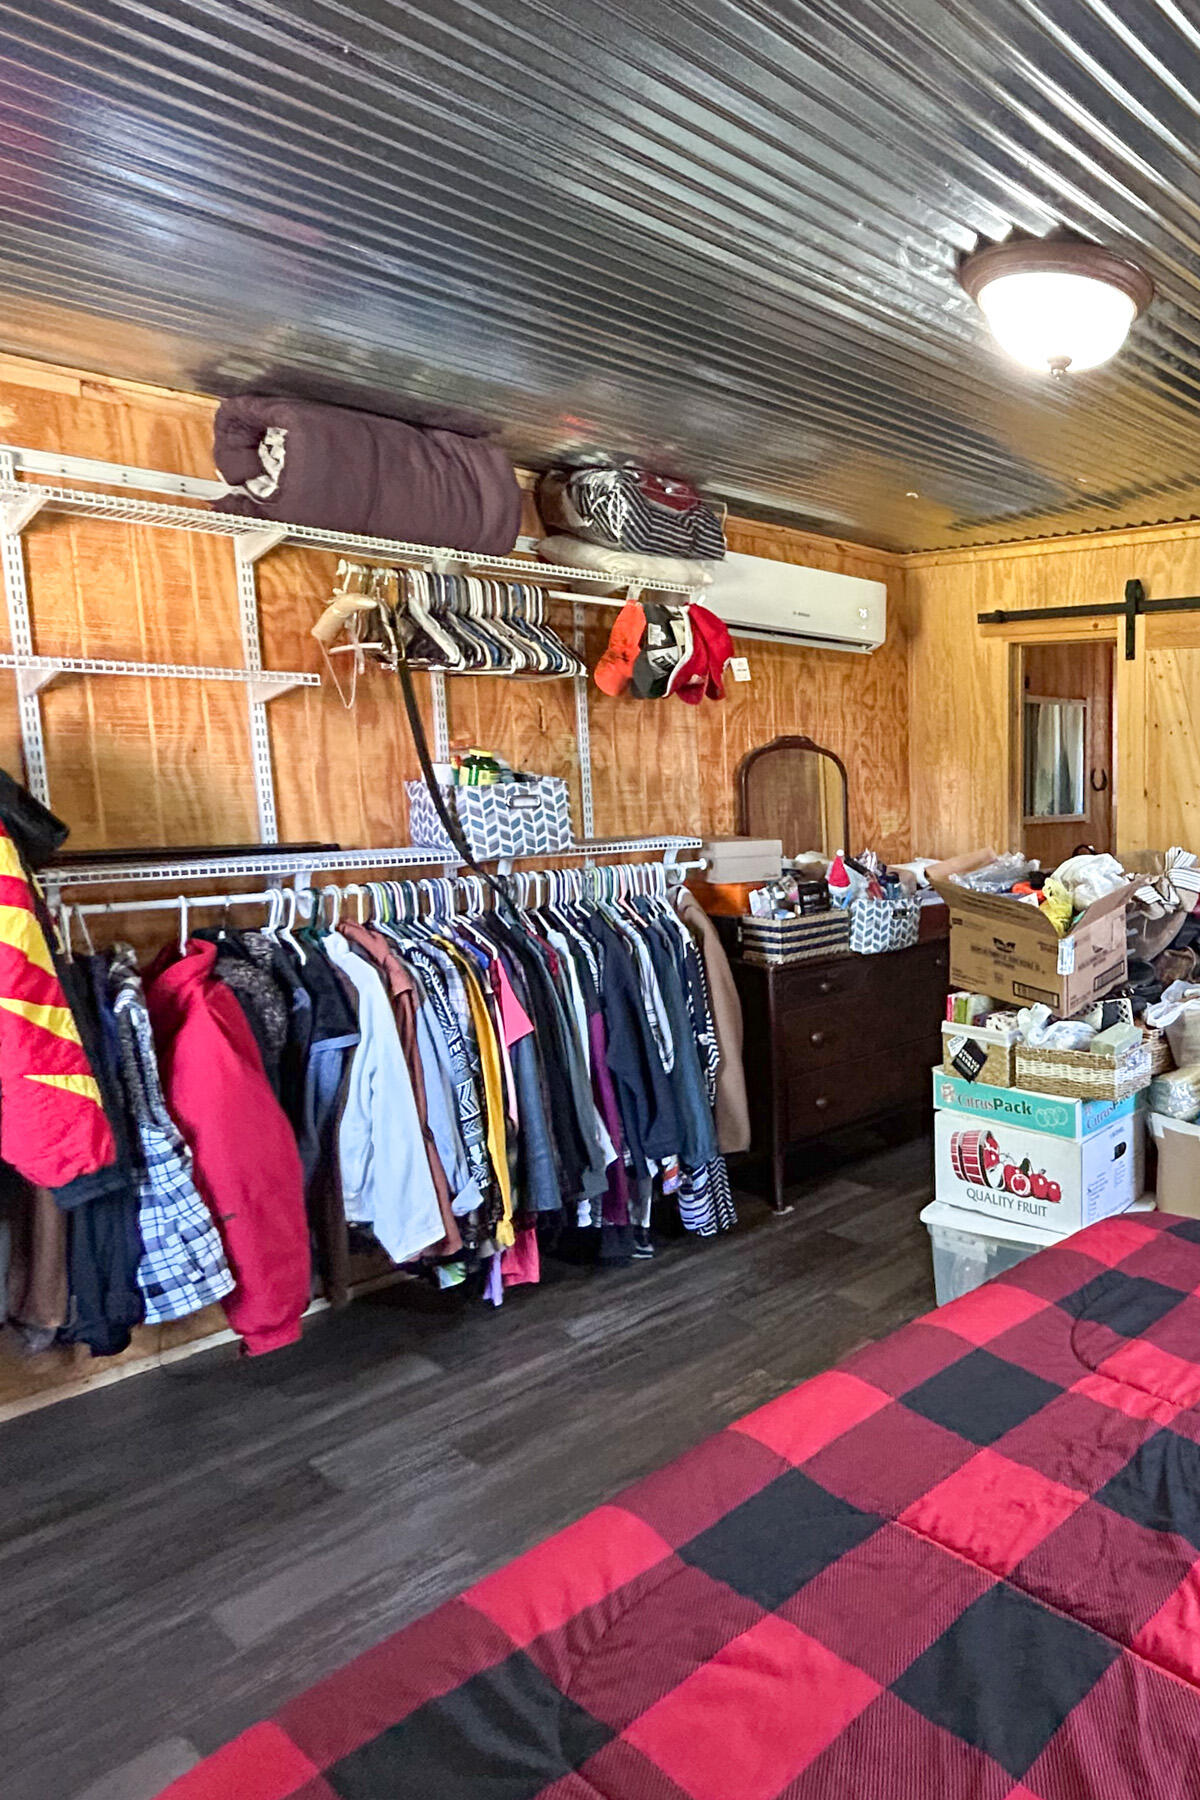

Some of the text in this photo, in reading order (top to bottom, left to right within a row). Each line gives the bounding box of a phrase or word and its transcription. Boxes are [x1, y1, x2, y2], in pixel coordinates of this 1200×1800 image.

[957, 1094, 1033, 1115] CitrusPack
[966, 1188, 1047, 1217] QUALITY FRUIT
